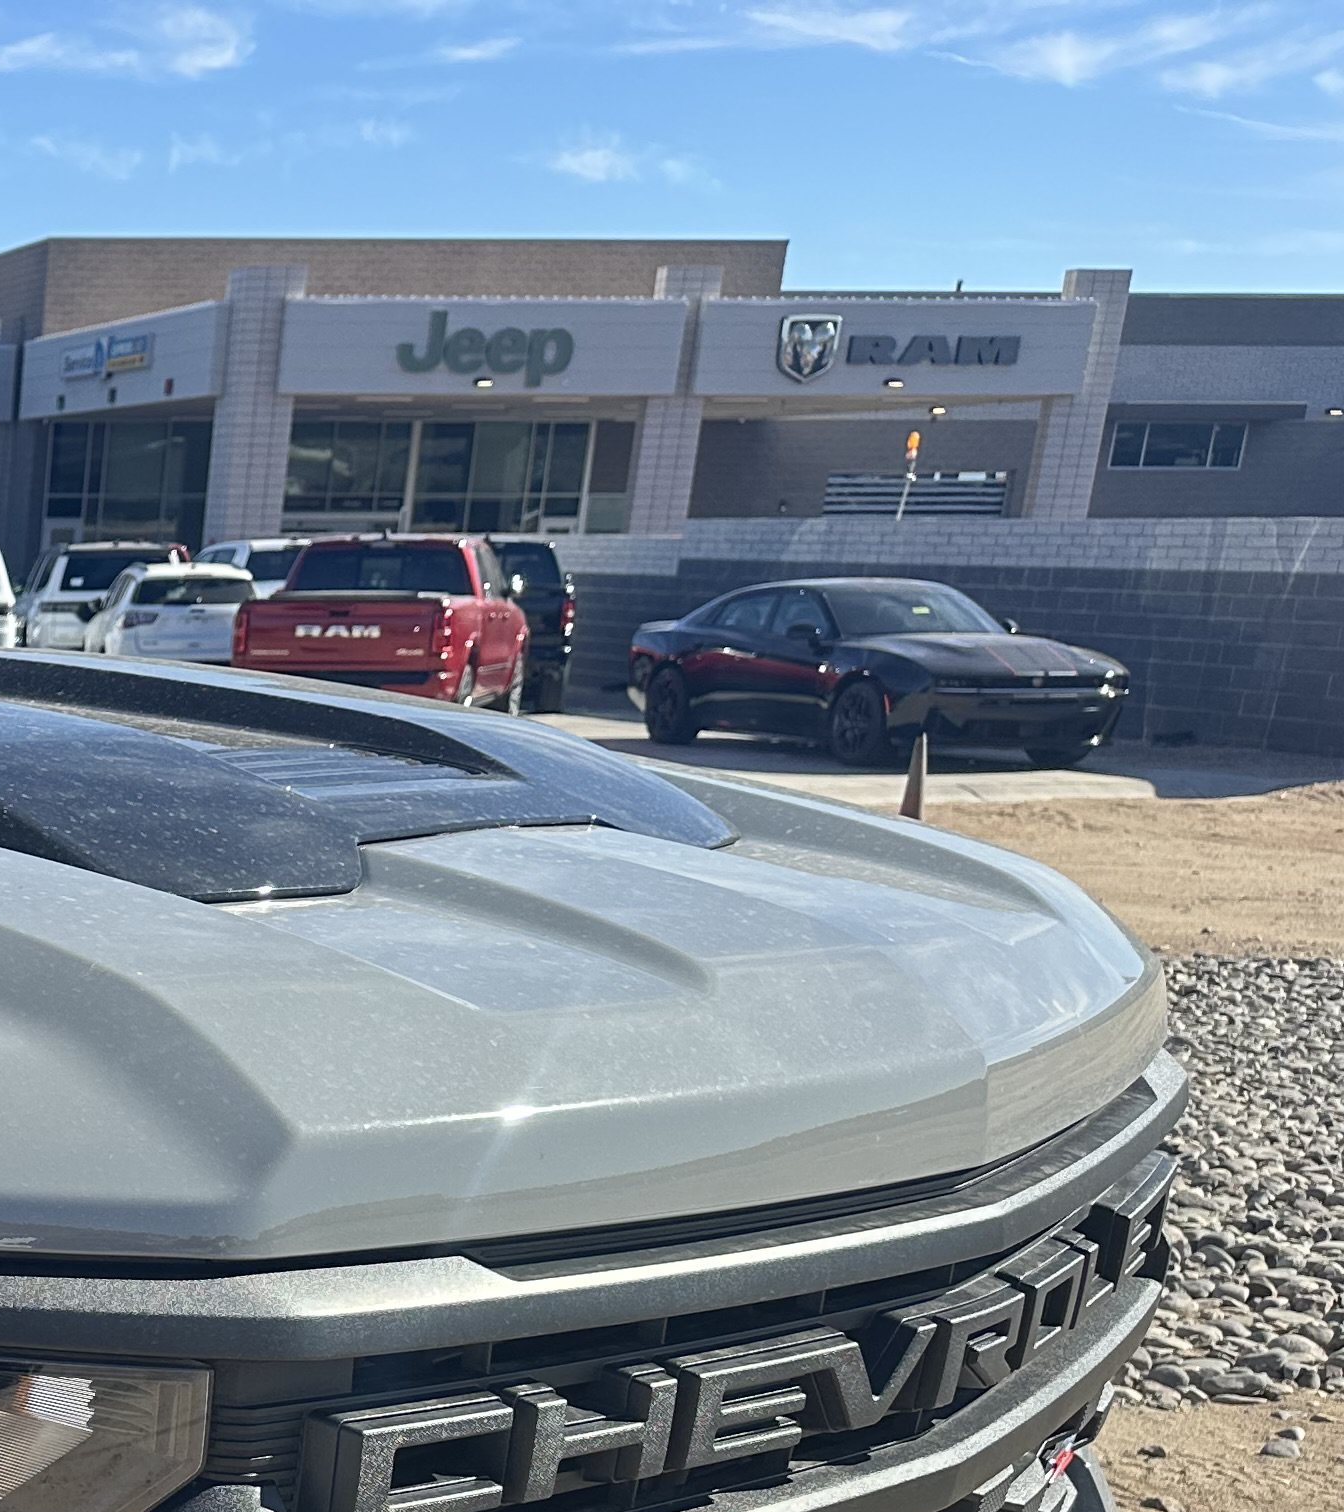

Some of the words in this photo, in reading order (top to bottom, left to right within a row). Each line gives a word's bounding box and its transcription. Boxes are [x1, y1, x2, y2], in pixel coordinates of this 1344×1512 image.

[396, 309, 574, 388] Jeep
[846, 335, 1022, 366] RAM
[294, 624, 381, 639] RAM
